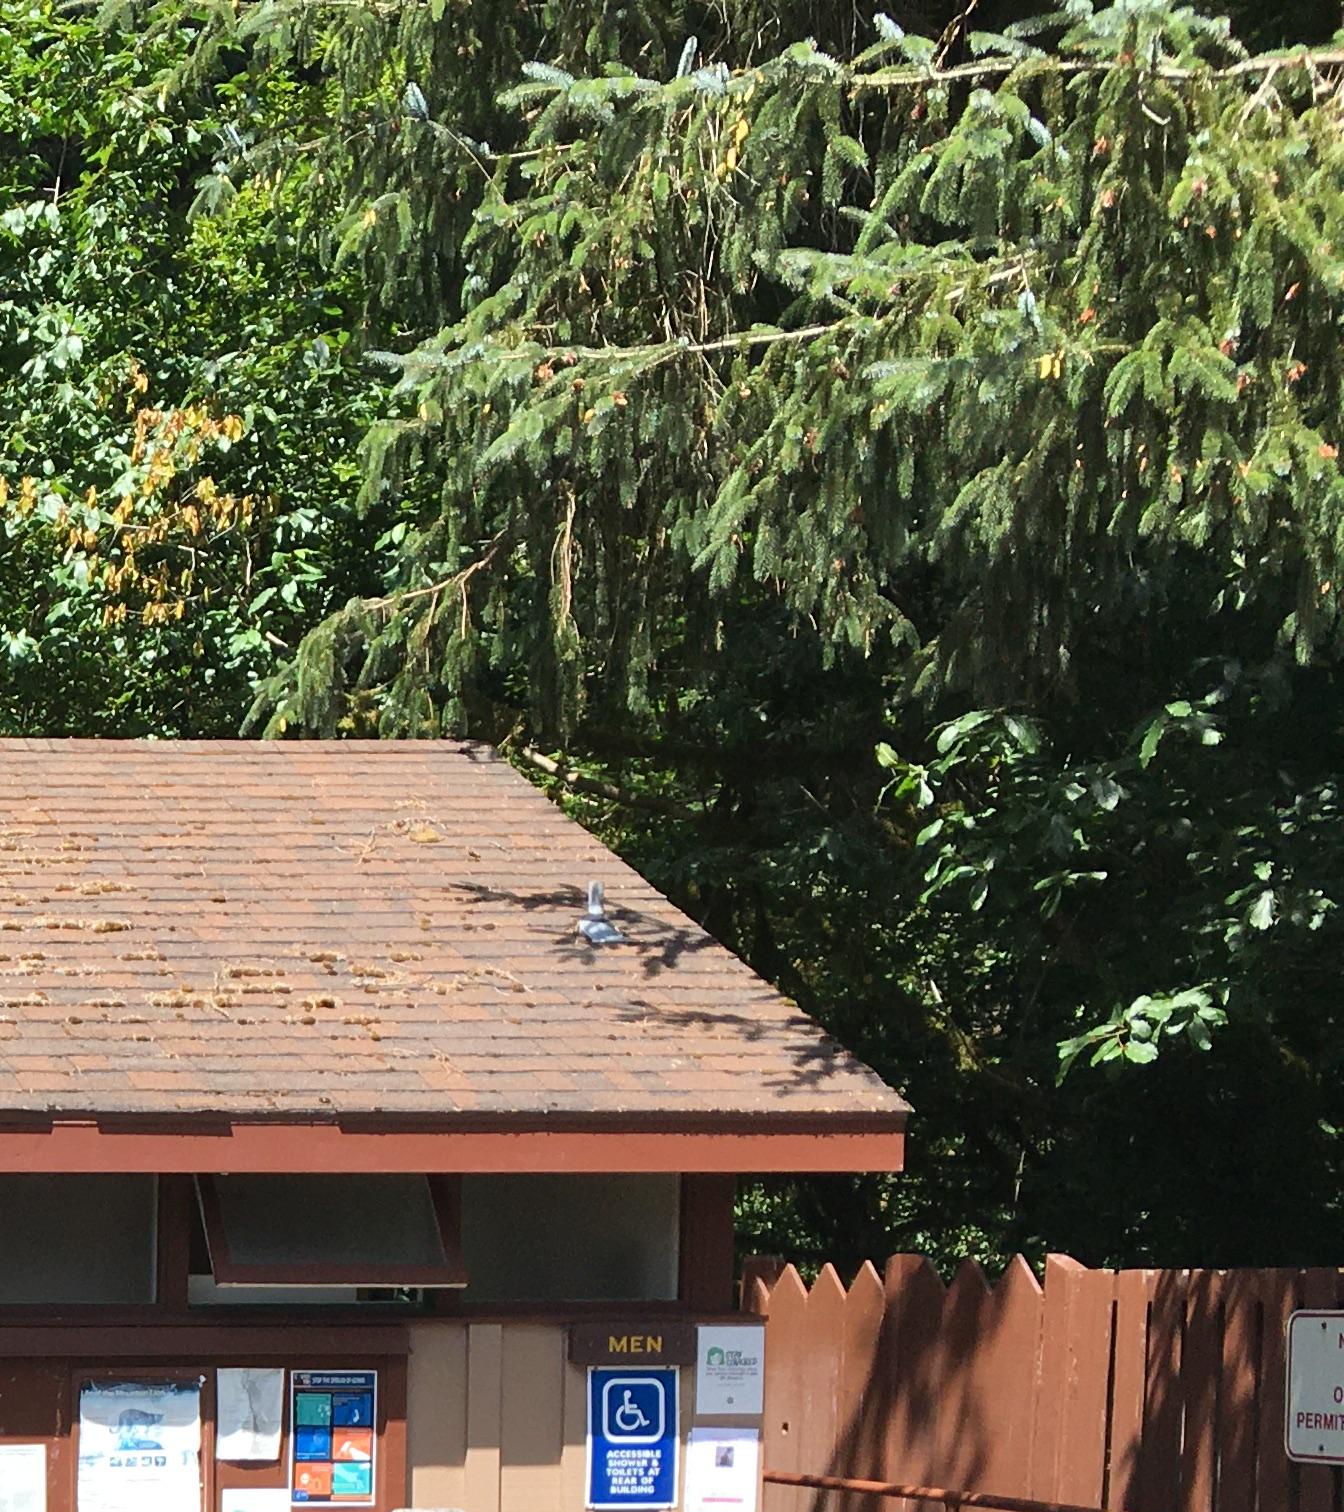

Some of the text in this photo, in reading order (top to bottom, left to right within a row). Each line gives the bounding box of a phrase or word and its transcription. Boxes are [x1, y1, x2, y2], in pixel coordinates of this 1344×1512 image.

[608, 1336, 662, 1352] MEN
[606, 1450, 662, 1458] ACCESSIBLE
[608, 1459, 659, 1467] SHOWER &
[606, 1468, 660, 1476] TOILETS AT
[611, 1476, 654, 1485] REAR OF
[610, 1485, 655, 1494] BUILDING
